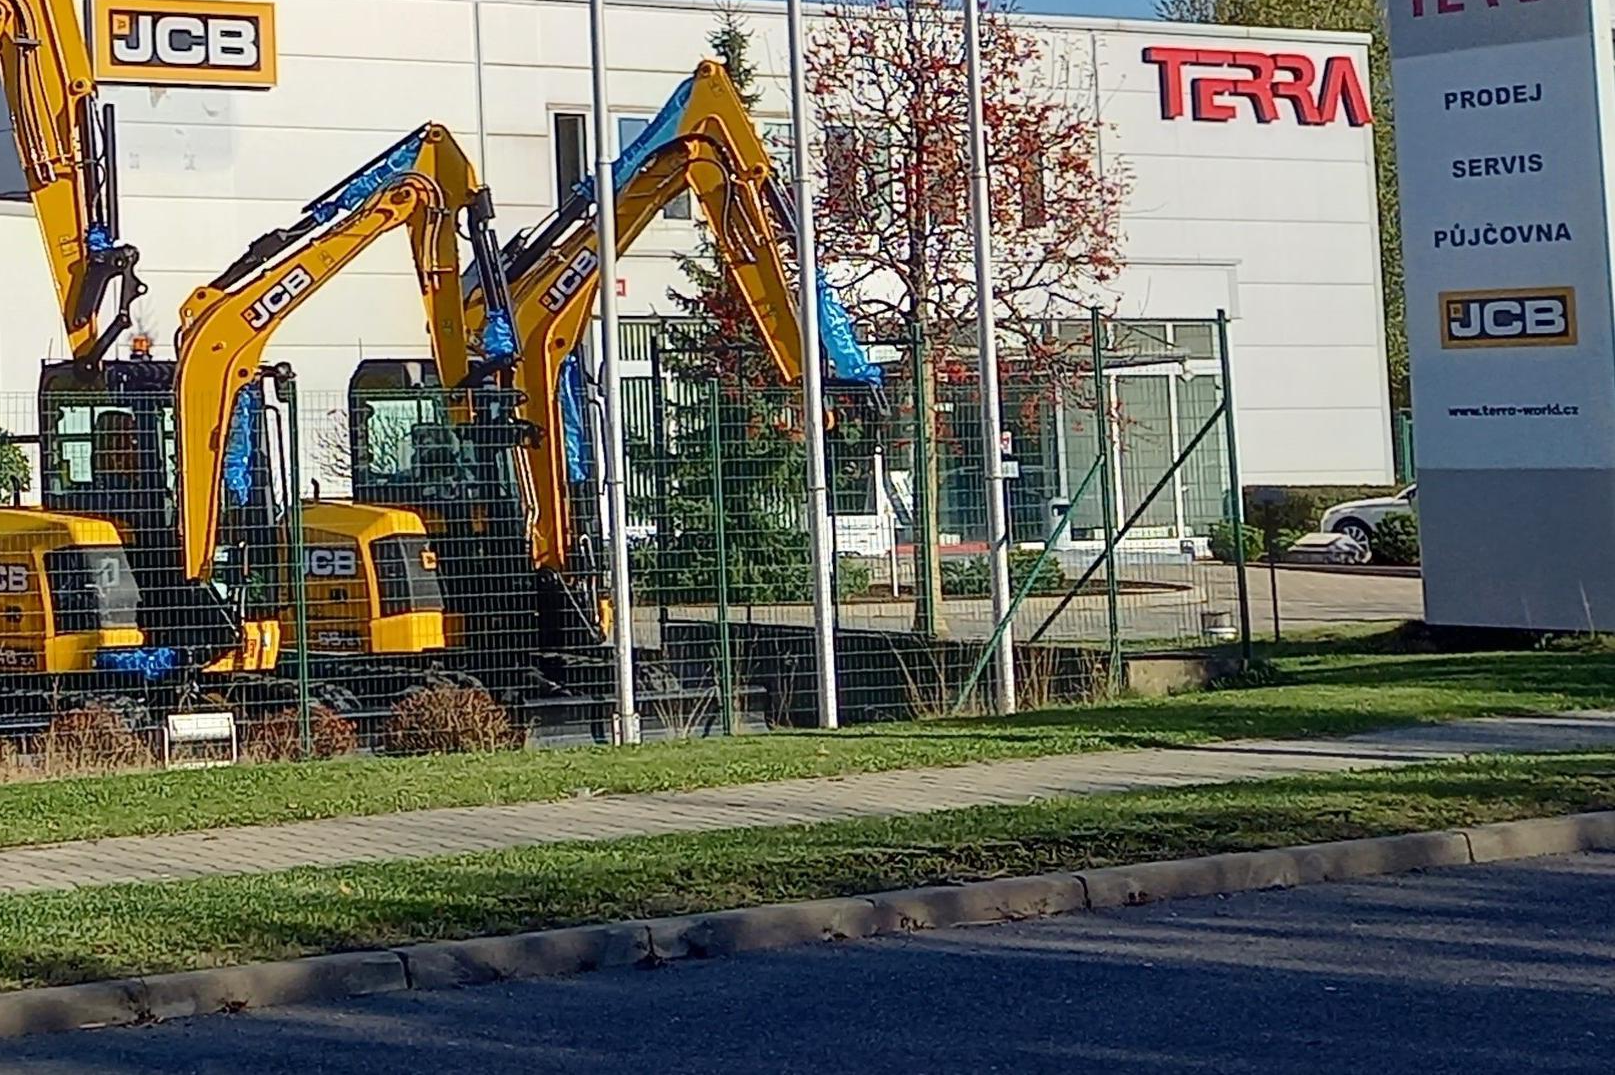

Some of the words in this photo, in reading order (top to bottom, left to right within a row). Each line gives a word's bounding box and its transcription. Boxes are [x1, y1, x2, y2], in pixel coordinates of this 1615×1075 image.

[112, 14, 258, 67] JCB
[1142, 46, 1373, 127] TERRA
[1443, 83, 1543, 111] PRODEJ
[1451, 153, 1544, 179] SERVIS
[1434, 222, 1573, 249] PŮJČOVNA
[249, 266, 313, 329] JCB
[547, 249, 598, 312] JCB
[1449, 299, 1566, 338] JCB
